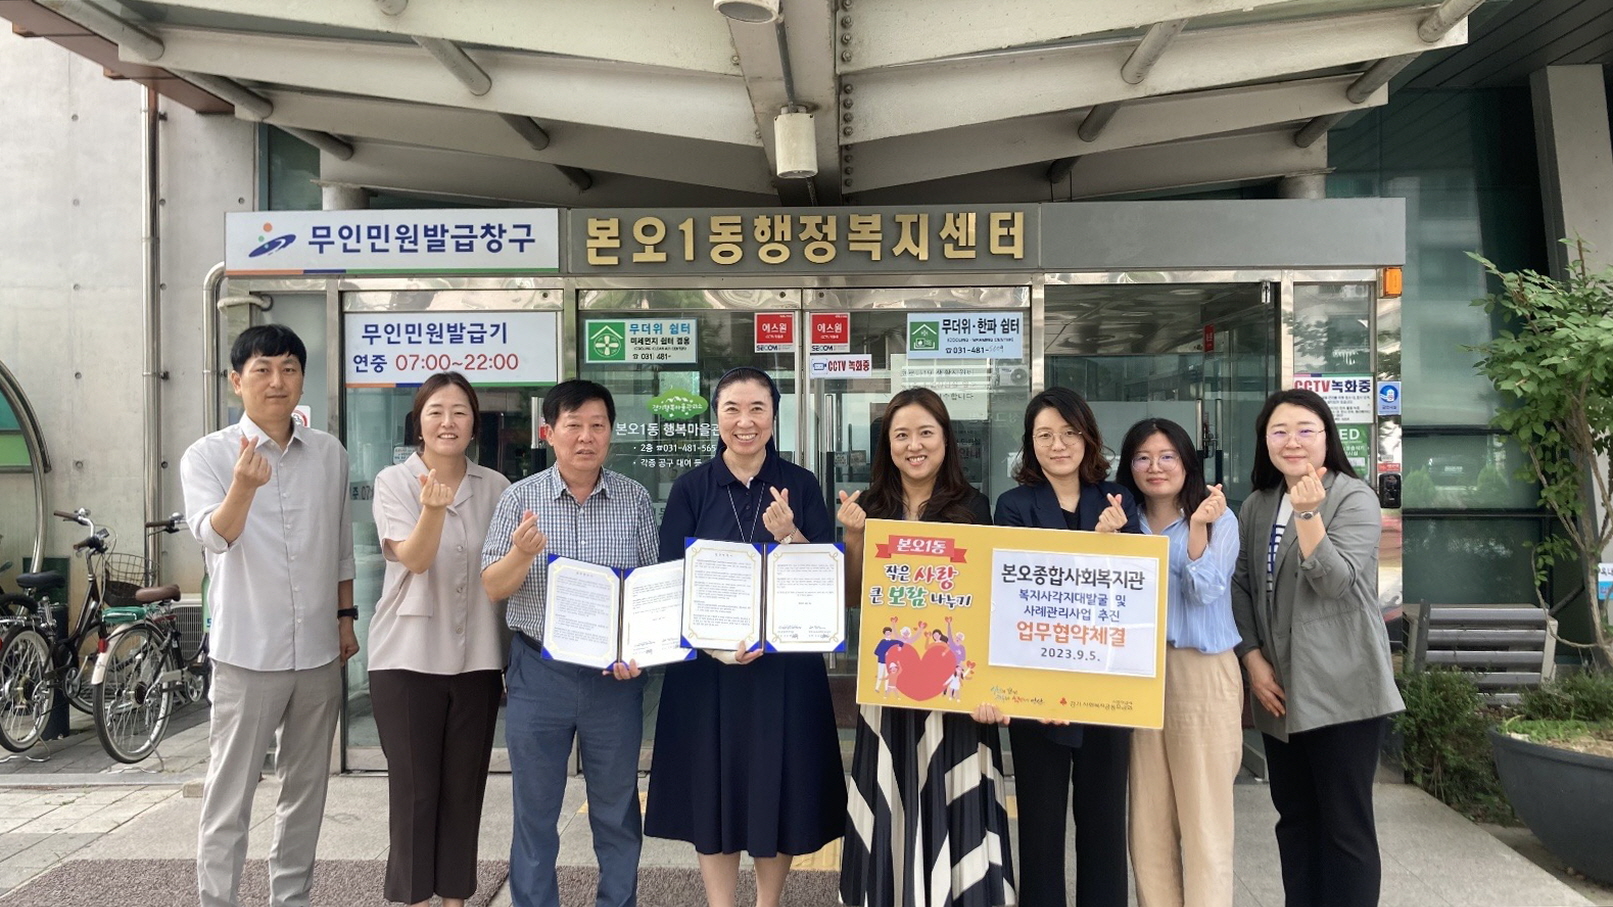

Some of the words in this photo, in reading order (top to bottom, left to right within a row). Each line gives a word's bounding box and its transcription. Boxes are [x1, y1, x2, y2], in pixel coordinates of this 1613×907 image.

[308, 222, 537, 254] 무인민원발급창구
[585, 211, 1025, 265] 본오1동행정복지센터
[361, 322, 508, 346] 무인민원발급기
[629, 323, 663, 335] 무더위
[669, 323, 691, 335] 쉼터
[761, 322, 787, 334] 에스원
[817, 322, 843, 334] 에스원
[1000, 318, 1020, 335] 쉼터
[352, 353, 388, 373] 연중
[395, 354, 519, 371] 07:00~22:00
[828, 360, 847, 371] CCTV
[848, 360, 870, 371] 녹화중
[615, 422, 660, 437] 본오1동
[896, 538, 947, 554] 본오1동
[885, 565, 909, 582] 작은
[913, 566, 958, 590] 사랑
[1001, 563, 1146, 591] 본오종합사회복지관
[869, 587, 883, 604] 큰
[889, 586, 928, 607] 보람
[930, 593, 972, 609] 나누기
[1018, 588, 1109, 607] 복지사각지대발굴
[1115, 594, 1127, 608] 및
[1023, 605, 1092, 622] 사례관리사업
[1097, 609, 1120, 623] 추진
[1016, 620, 1127, 648] 업무협약체결
[1040, 647, 1101, 662] 2023.9.5.
